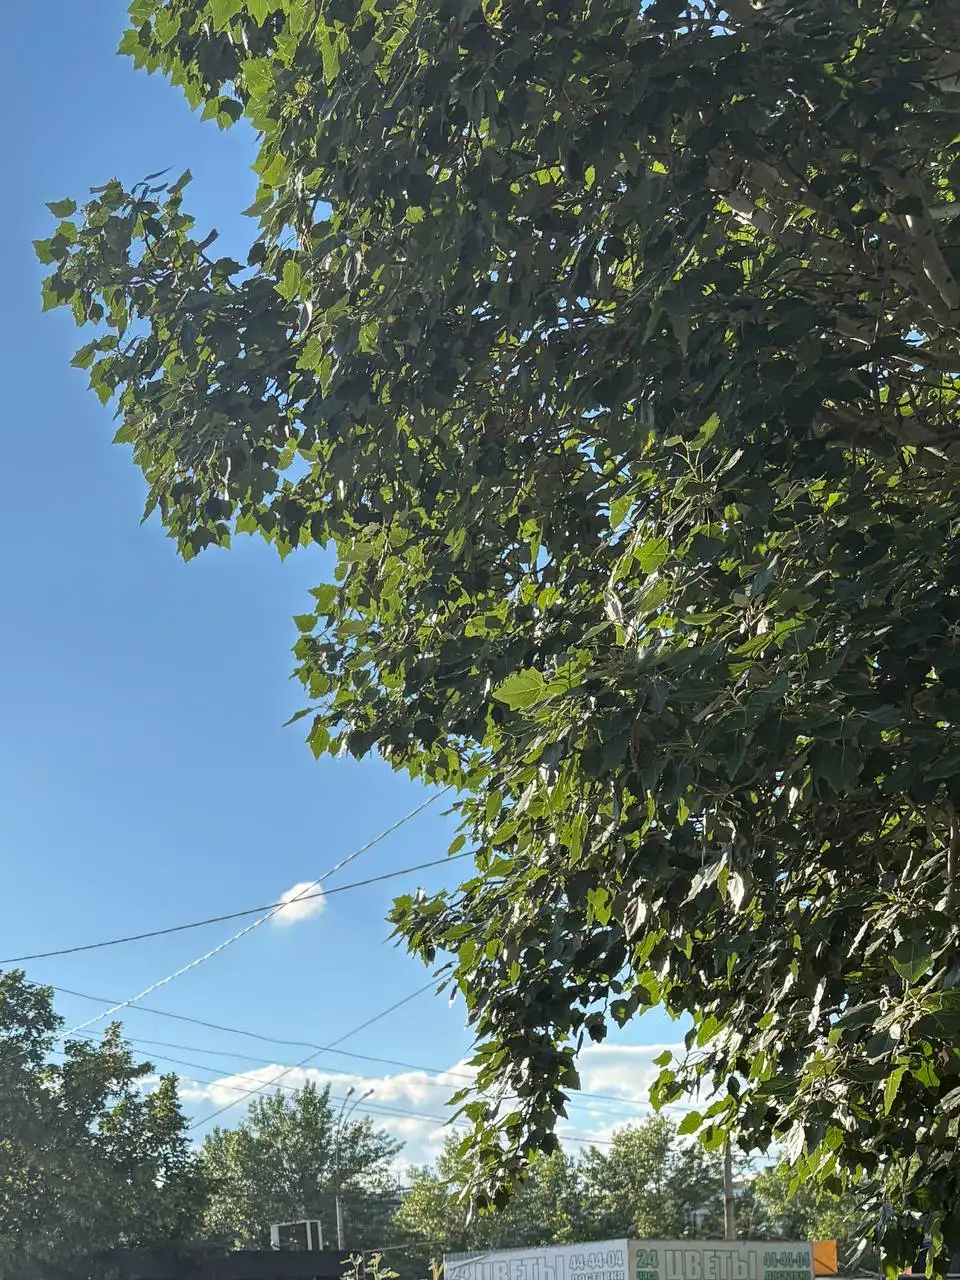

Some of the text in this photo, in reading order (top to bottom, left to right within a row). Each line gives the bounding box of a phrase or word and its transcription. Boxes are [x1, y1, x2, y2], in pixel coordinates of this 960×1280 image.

[449, 1262, 472, 1280] 24
[569, 1250, 623, 1270] 44-44-04
[636, 1248, 659, 1269] 24
